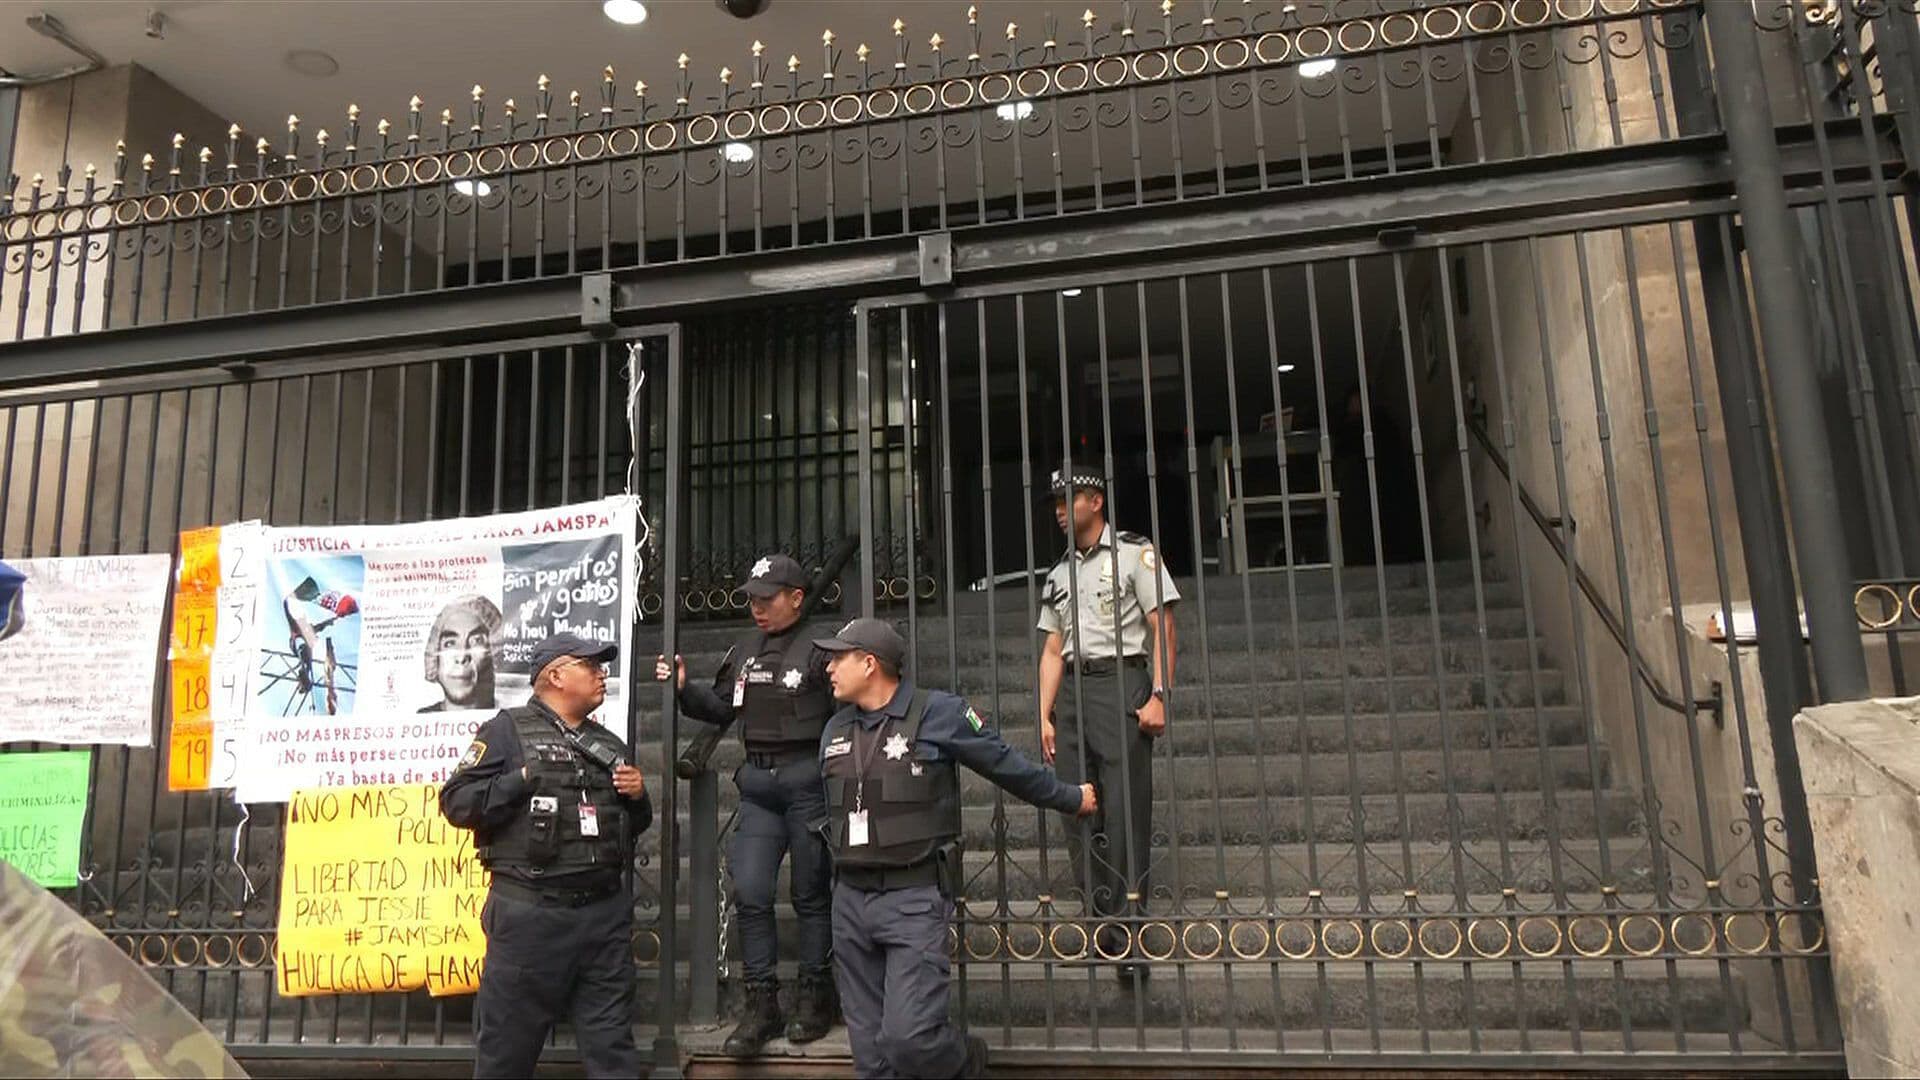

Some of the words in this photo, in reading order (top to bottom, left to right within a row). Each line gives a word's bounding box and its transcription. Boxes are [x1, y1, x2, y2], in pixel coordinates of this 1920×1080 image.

[404, 571, 448, 583] MUNDIAL
[438, 555, 488, 569] protestas
[504, 573, 531, 592] Sin
[535, 551, 618, 592] perritos
[184, 615, 208, 649] 17
[182, 676, 209, 713] 18
[401, 721, 480, 738] POLÍTICO
[183, 740, 208, 780] 19
[224, 739, 237, 781] 5
[350, 744, 459, 765] persecución
[352, 770, 395, 786] basta
[403, 769, 424, 784] de
[431, 768, 453, 783] si
[350, 787, 408, 819] MAS
[0, 825, 58, 851] LICIAS
[397, 817, 460, 845] POLIT
[294, 857, 407, 895] LIBERTAD
[295, 897, 343, 928] PARA
[358, 896, 433, 924] JESSIE
[381, 952, 408, 990] DE
[426, 954, 486, 988] HAM
